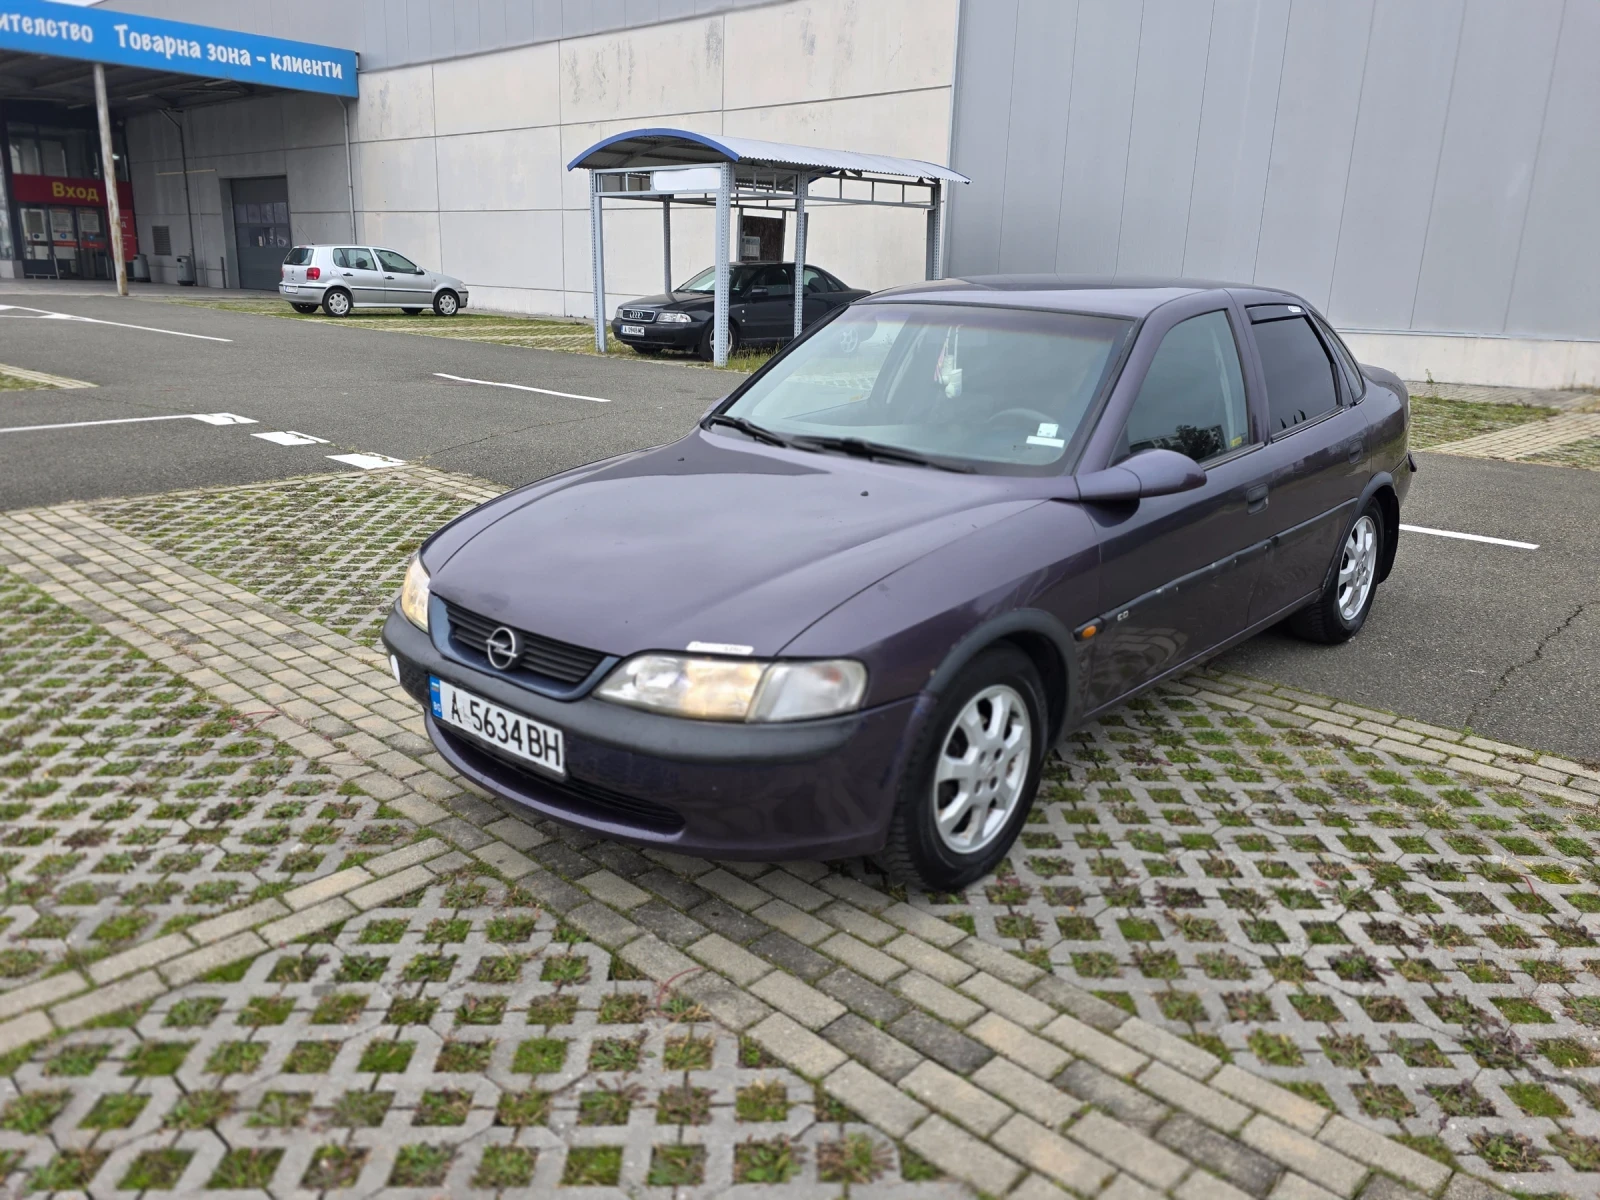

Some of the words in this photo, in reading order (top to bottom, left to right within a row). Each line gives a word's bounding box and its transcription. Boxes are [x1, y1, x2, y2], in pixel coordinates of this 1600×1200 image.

[0, 13, 94, 43] ителство
[114, 24, 202, 60] Товарна
[206, 42, 252, 67] зона
[271, 53, 344, 79] клиенти
[52, 181, 99, 202] Вход
[451, 691, 462, 723] A
